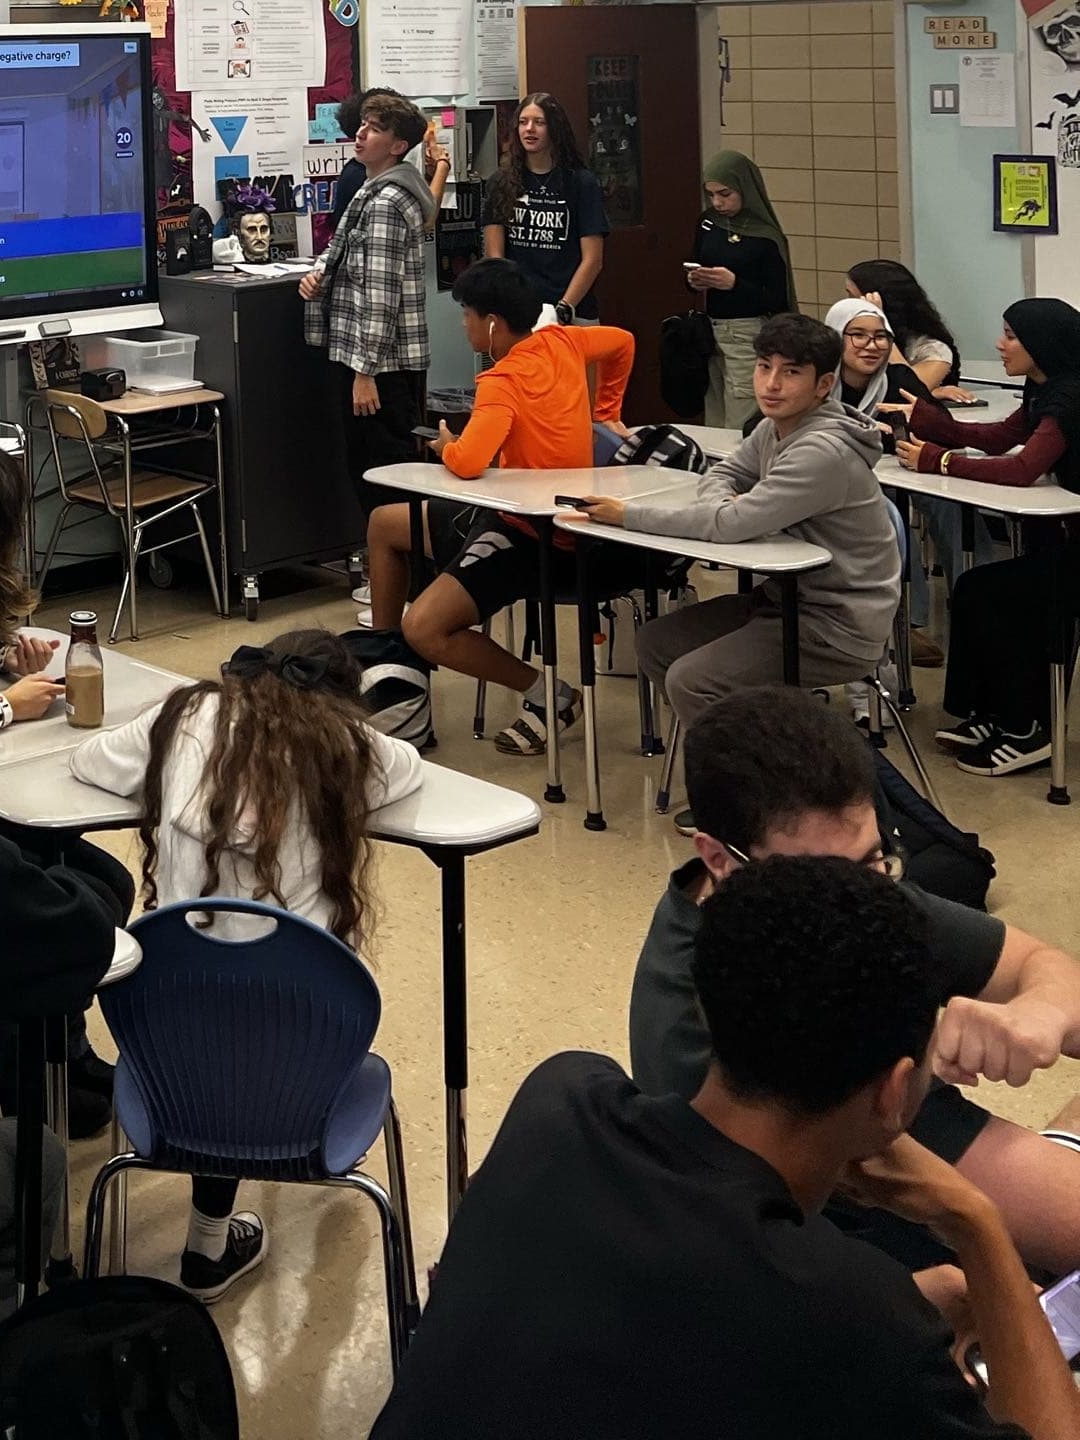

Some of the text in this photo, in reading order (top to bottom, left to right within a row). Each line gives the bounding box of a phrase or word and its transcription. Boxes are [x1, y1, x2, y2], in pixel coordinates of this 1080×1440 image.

[929, 20, 980, 30] READ
[937, 36, 989, 45] MORE
[35, 50, 71, 62] charge?
[117, 132, 131, 144] 20
[308, 145, 347, 174] writ
[529, 210, 565, 228] YORK
[509, 226, 554, 242] ST. 1788
